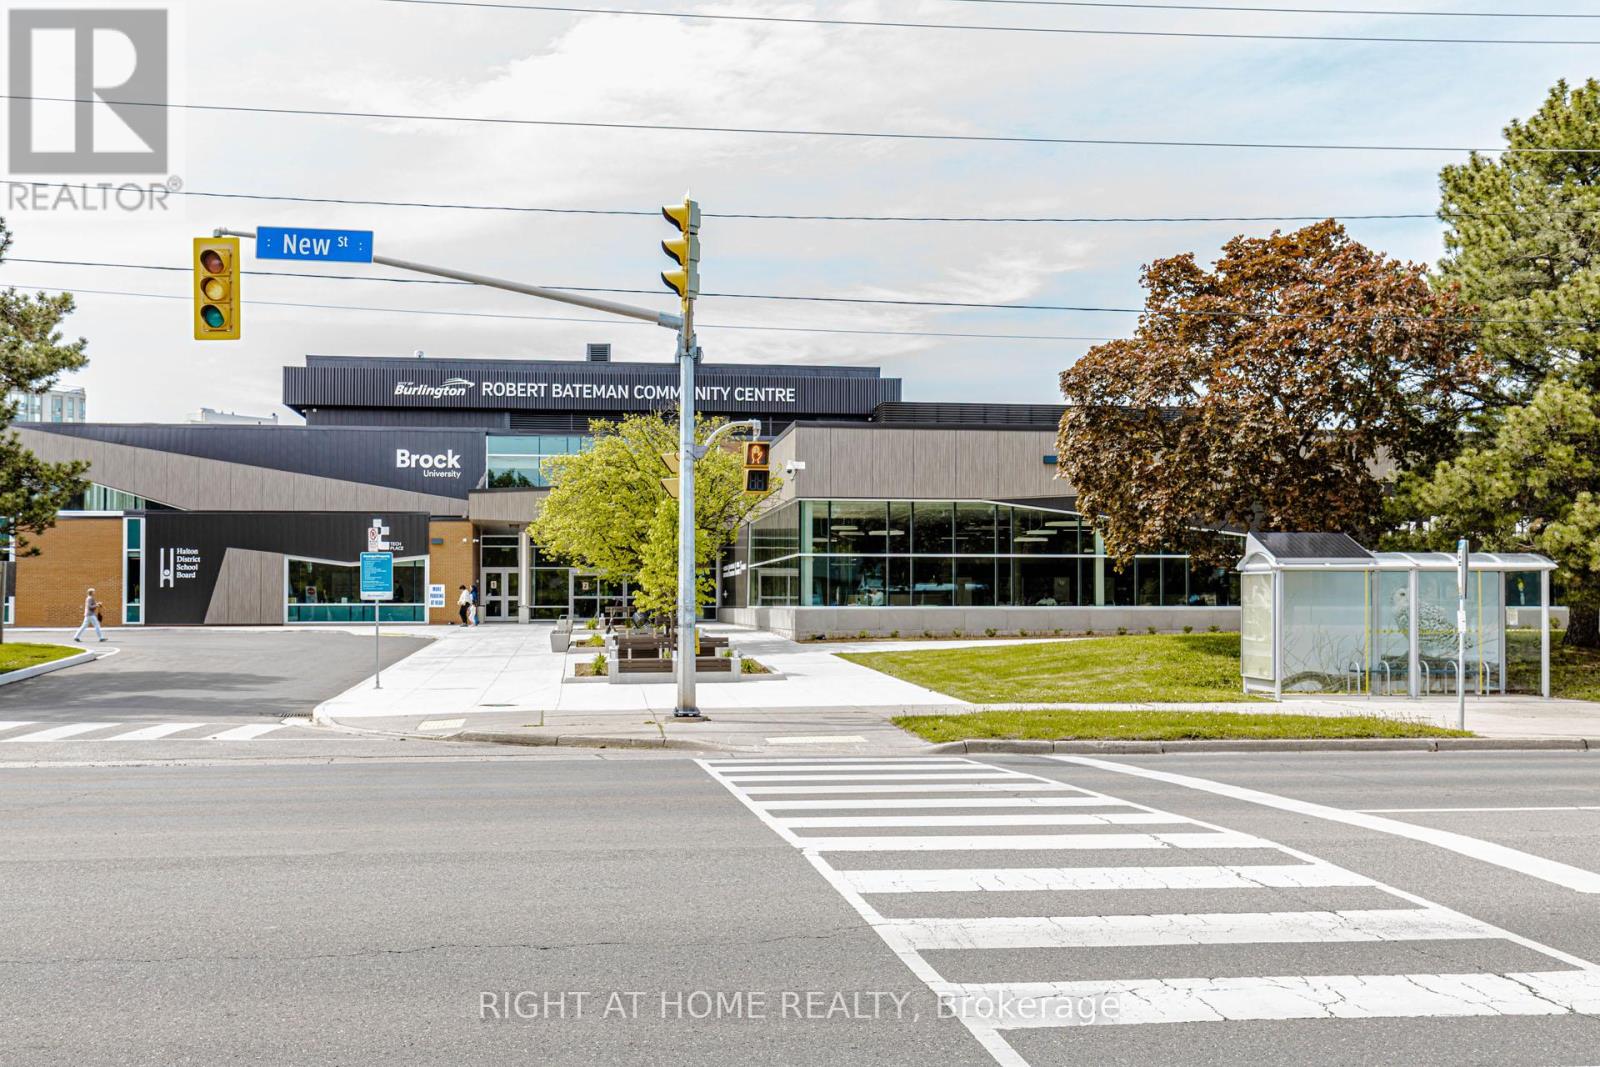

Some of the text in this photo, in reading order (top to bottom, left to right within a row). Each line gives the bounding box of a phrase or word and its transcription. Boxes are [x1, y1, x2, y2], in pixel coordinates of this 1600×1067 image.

[283, 233, 349, 256] New St
[394, 384, 466, 399] Burlington
[481, 381, 796, 402] ROBERT BATEMAN COMMNITY CENTRE
[396, 448, 461, 469] Brock
[423, 469, 462, 479] University
[176, 547, 199, 555] Halton
[176, 555, 201, 563] District
[176, 563, 198, 571] School
[176, 571, 196, 579] Board
